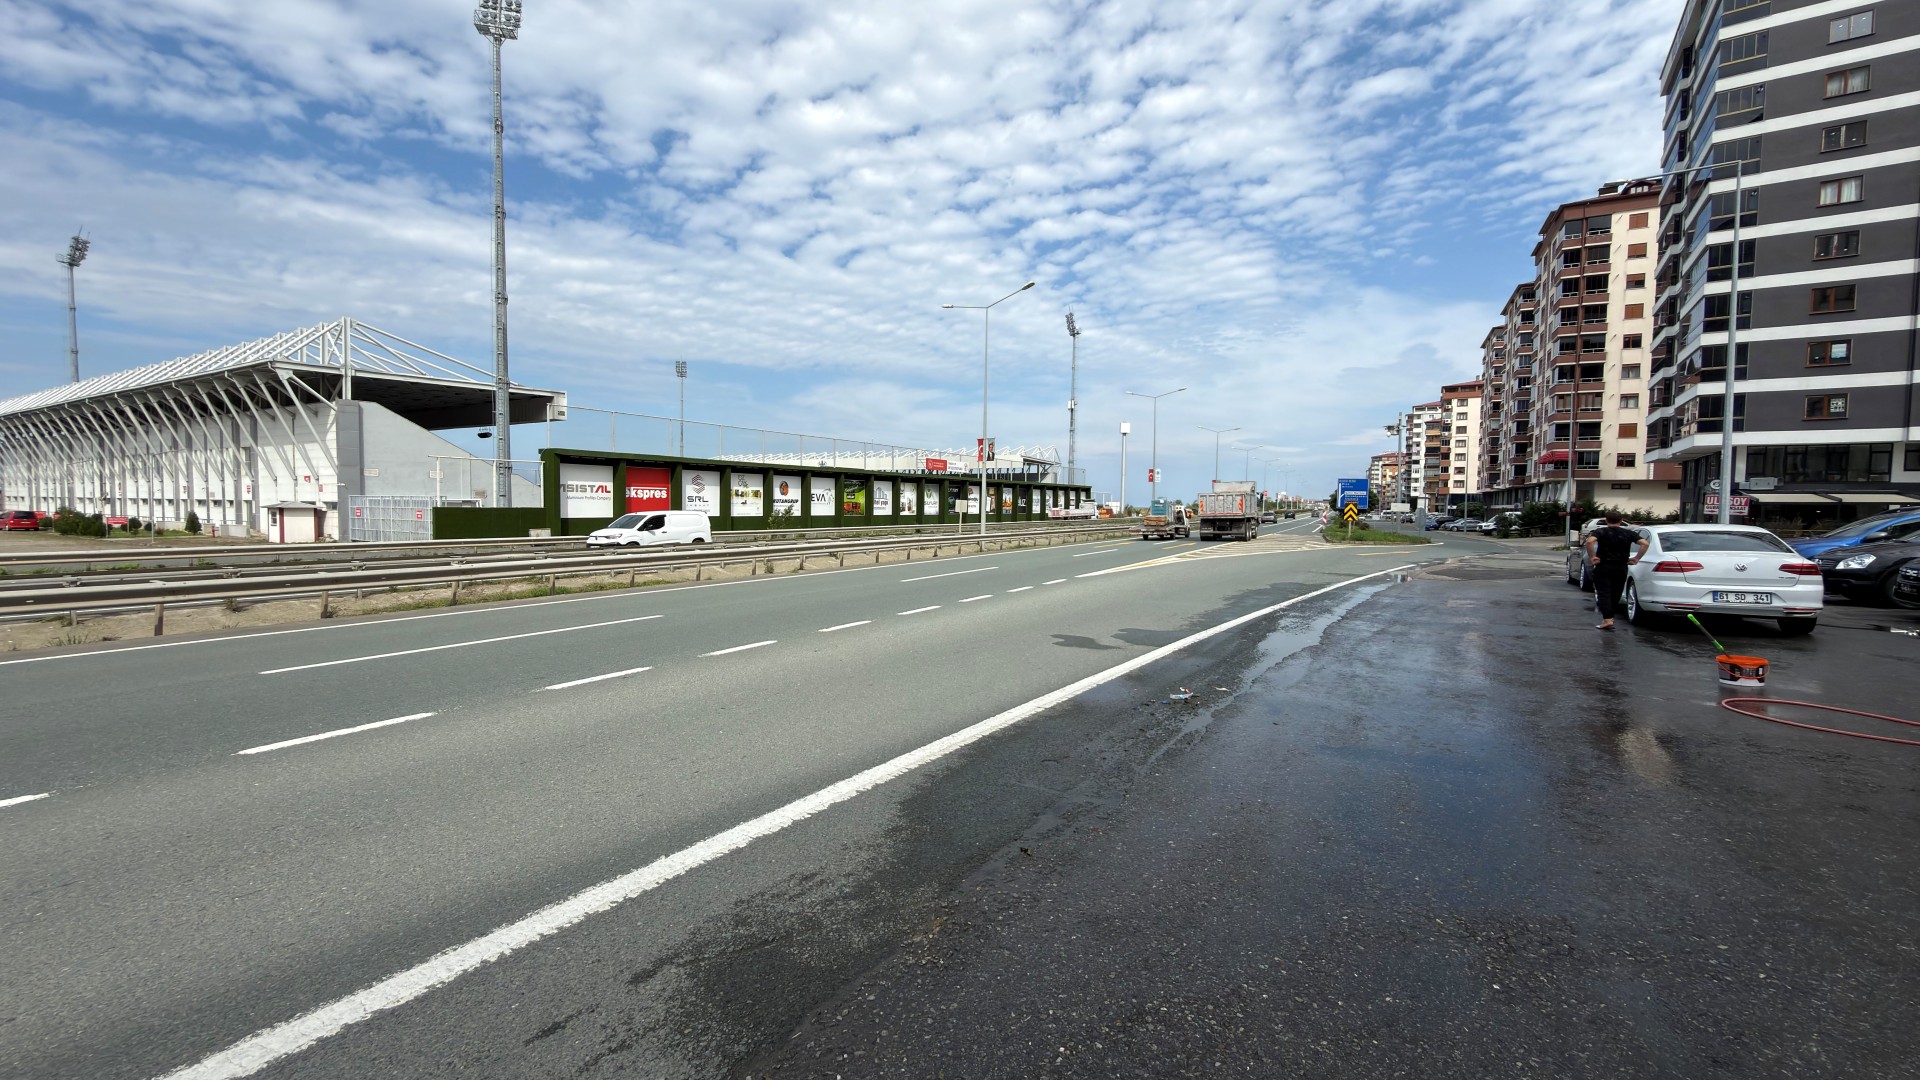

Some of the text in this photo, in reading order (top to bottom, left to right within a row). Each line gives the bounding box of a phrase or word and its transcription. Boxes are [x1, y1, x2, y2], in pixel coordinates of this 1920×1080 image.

[1706, 497, 1747, 505] ULSOY
[1719, 592, 1769, 602] 61 SD 341
